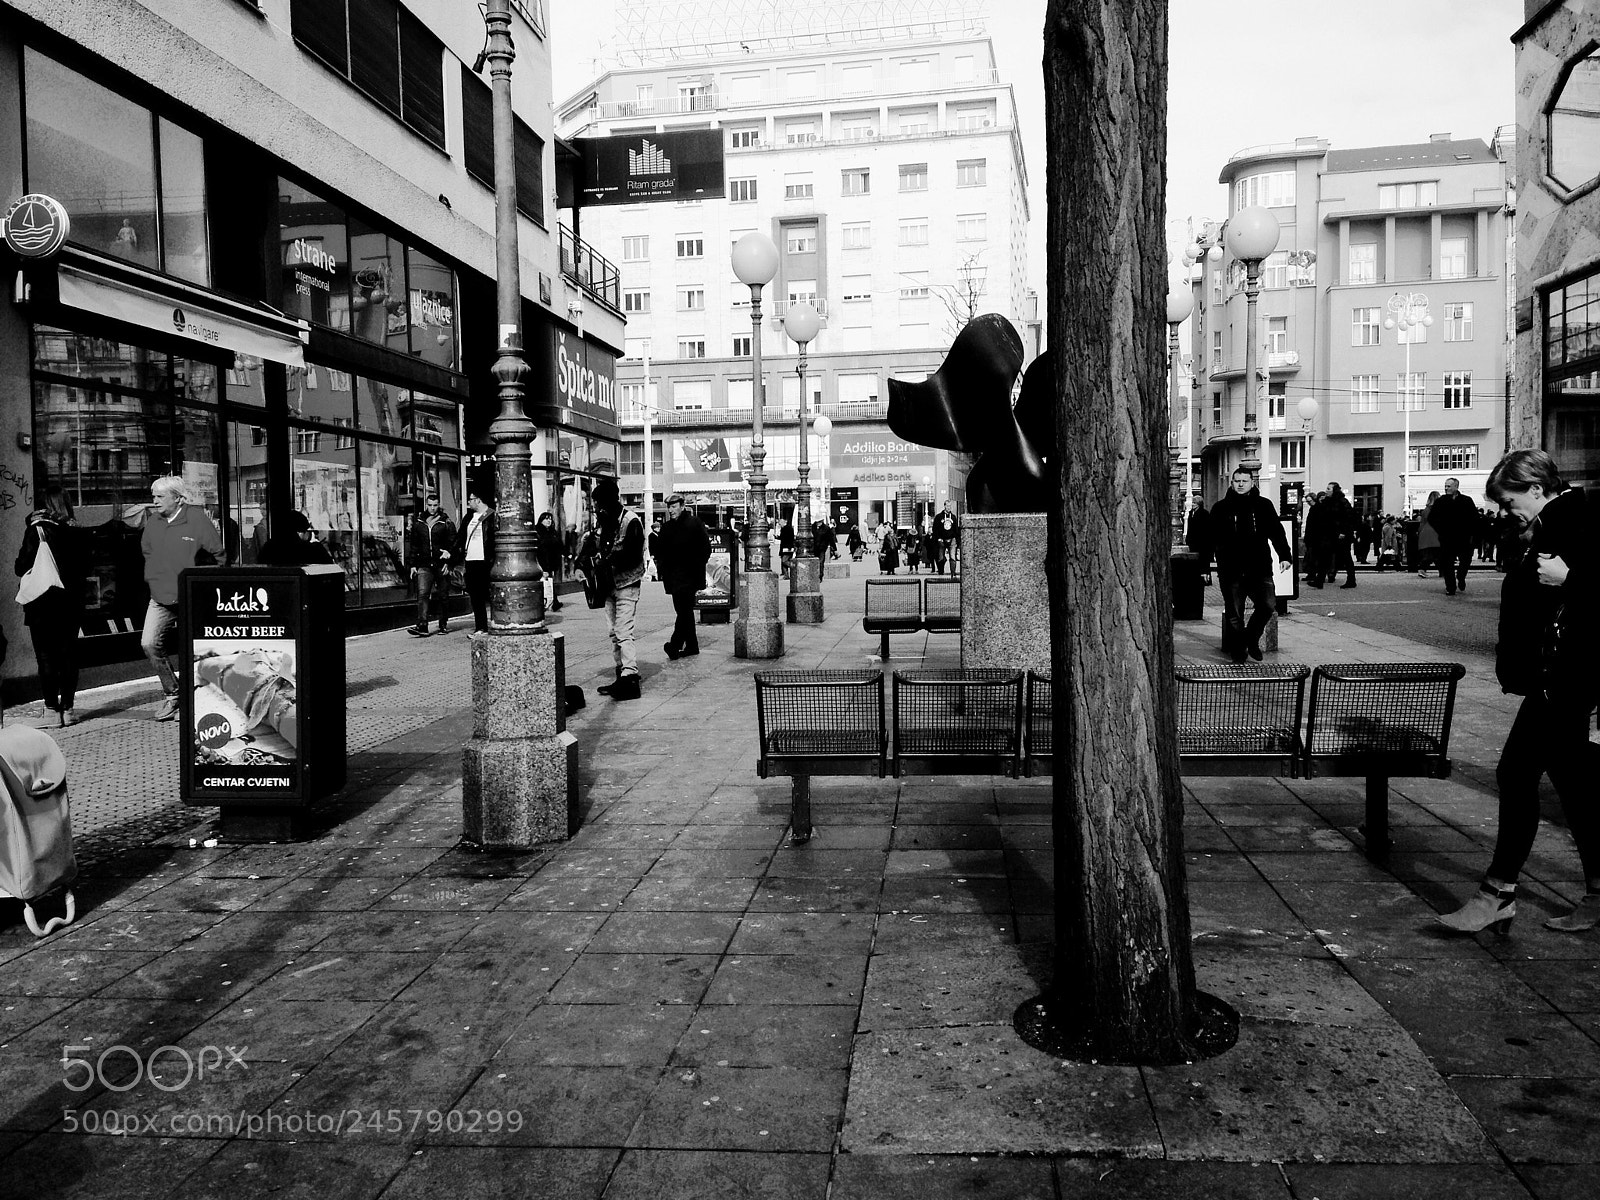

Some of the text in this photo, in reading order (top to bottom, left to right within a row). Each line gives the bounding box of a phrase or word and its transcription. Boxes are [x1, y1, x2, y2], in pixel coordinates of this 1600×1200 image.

[627, 179, 675, 190] Ritam grada
[5, 196, 60, 222] NAVIGARE
[294, 238, 336, 274] strane
[295, 267, 330, 292] international
[187, 323, 220, 342] navigare
[558, 331, 596, 408] Špica
[843, 441, 920, 454] Addiko Bank
[887, 455, 909, 463] 2+2=4
[853, 472, 912, 483] Addiko Bank
[203, 626, 285, 637] ROAST BEEF
[199, 721, 230, 742] NOVO
[203, 777, 290, 787] CENTAR CVJETNI
